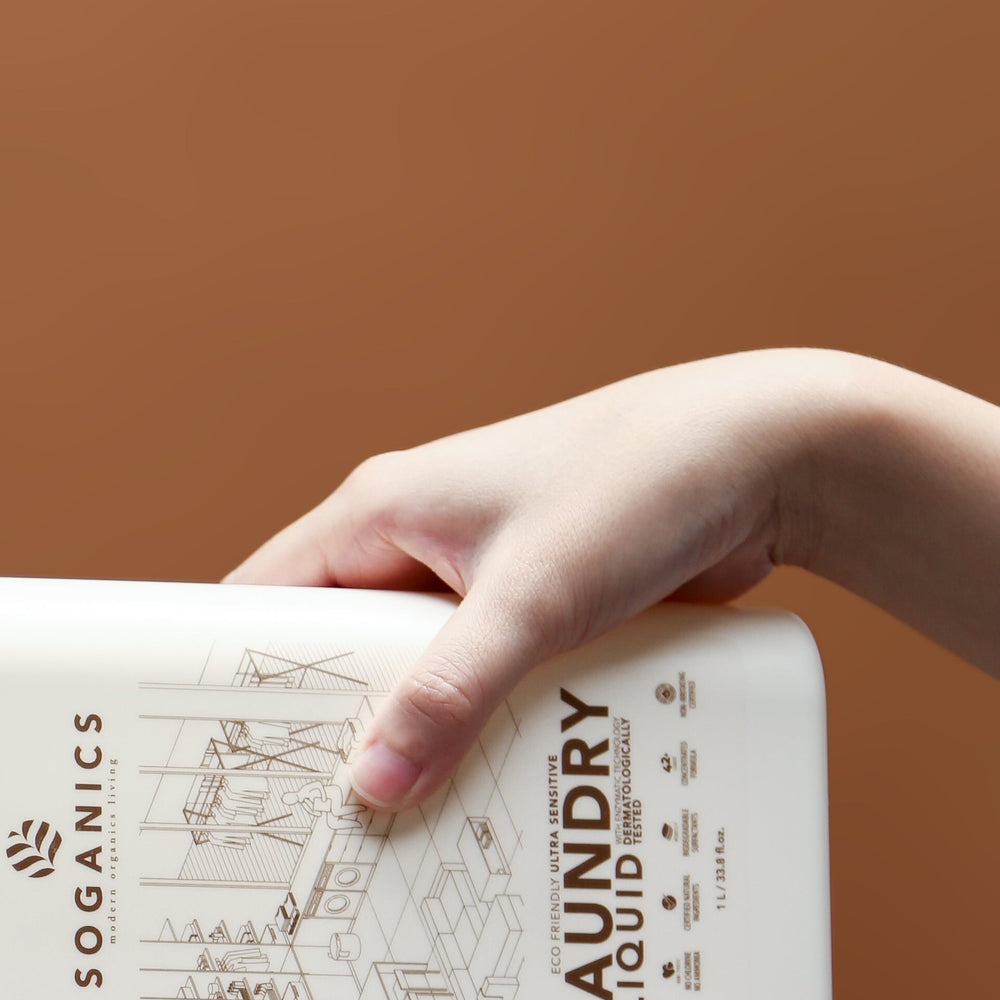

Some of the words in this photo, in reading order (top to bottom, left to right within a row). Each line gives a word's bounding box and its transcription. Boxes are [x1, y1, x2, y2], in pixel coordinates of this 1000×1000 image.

[107, 758, 118, 804] living
[548, 755, 559, 824] SENSITIVE
[621, 717, 632, 845] DERMATOLOGICALLY
[108, 813, 118, 879] organics
[633, 800, 642, 845] TESTED
[74, 713, 103, 988] SOGANICS
[550, 831, 559, 873] ULTRA
[716, 858, 725, 882] 33.8
[108, 889, 116, 944] modern
[550, 877, 560, 941] FRIENDLY
[551, 947, 561, 975] ECO
